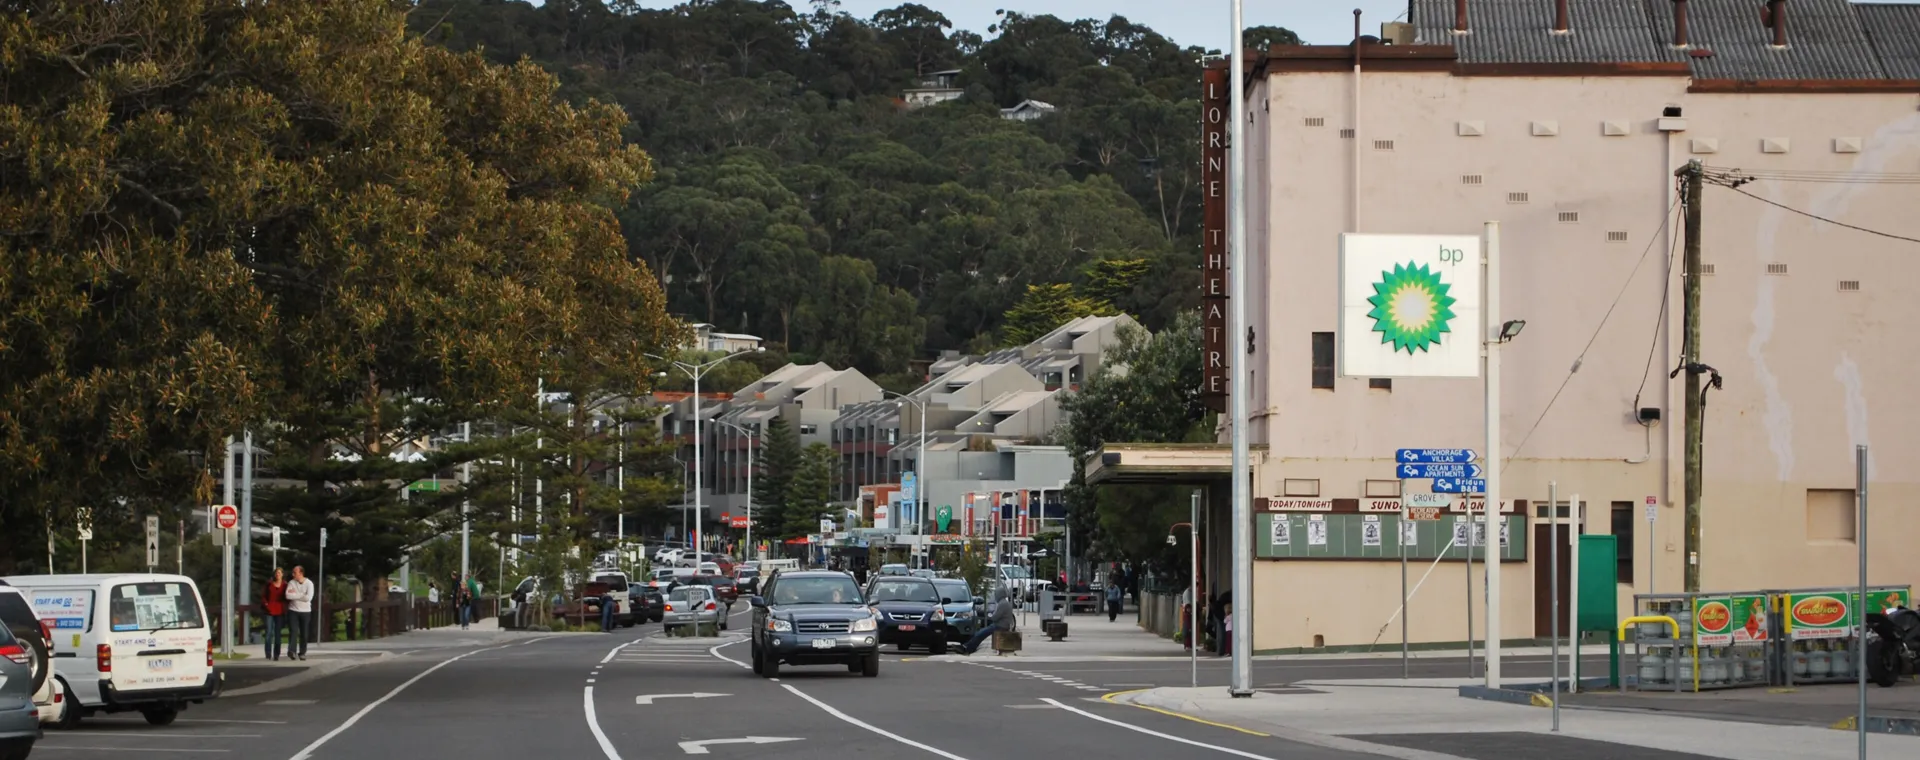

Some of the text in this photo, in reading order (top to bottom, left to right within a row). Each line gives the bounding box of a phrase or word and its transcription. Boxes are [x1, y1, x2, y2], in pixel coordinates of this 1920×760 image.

[1209, 83, 1221, 198] LORNE
[1439, 244, 1464, 267] bp
[1209, 229, 1222, 393] THEATRE
[1413, 494, 1436, 502] GROVE
[1269, 500, 1331, 508] TODAY/TONIGHT
[1371, 501, 1402, 510] SUND
[1459, 501, 1505, 510] MONY
